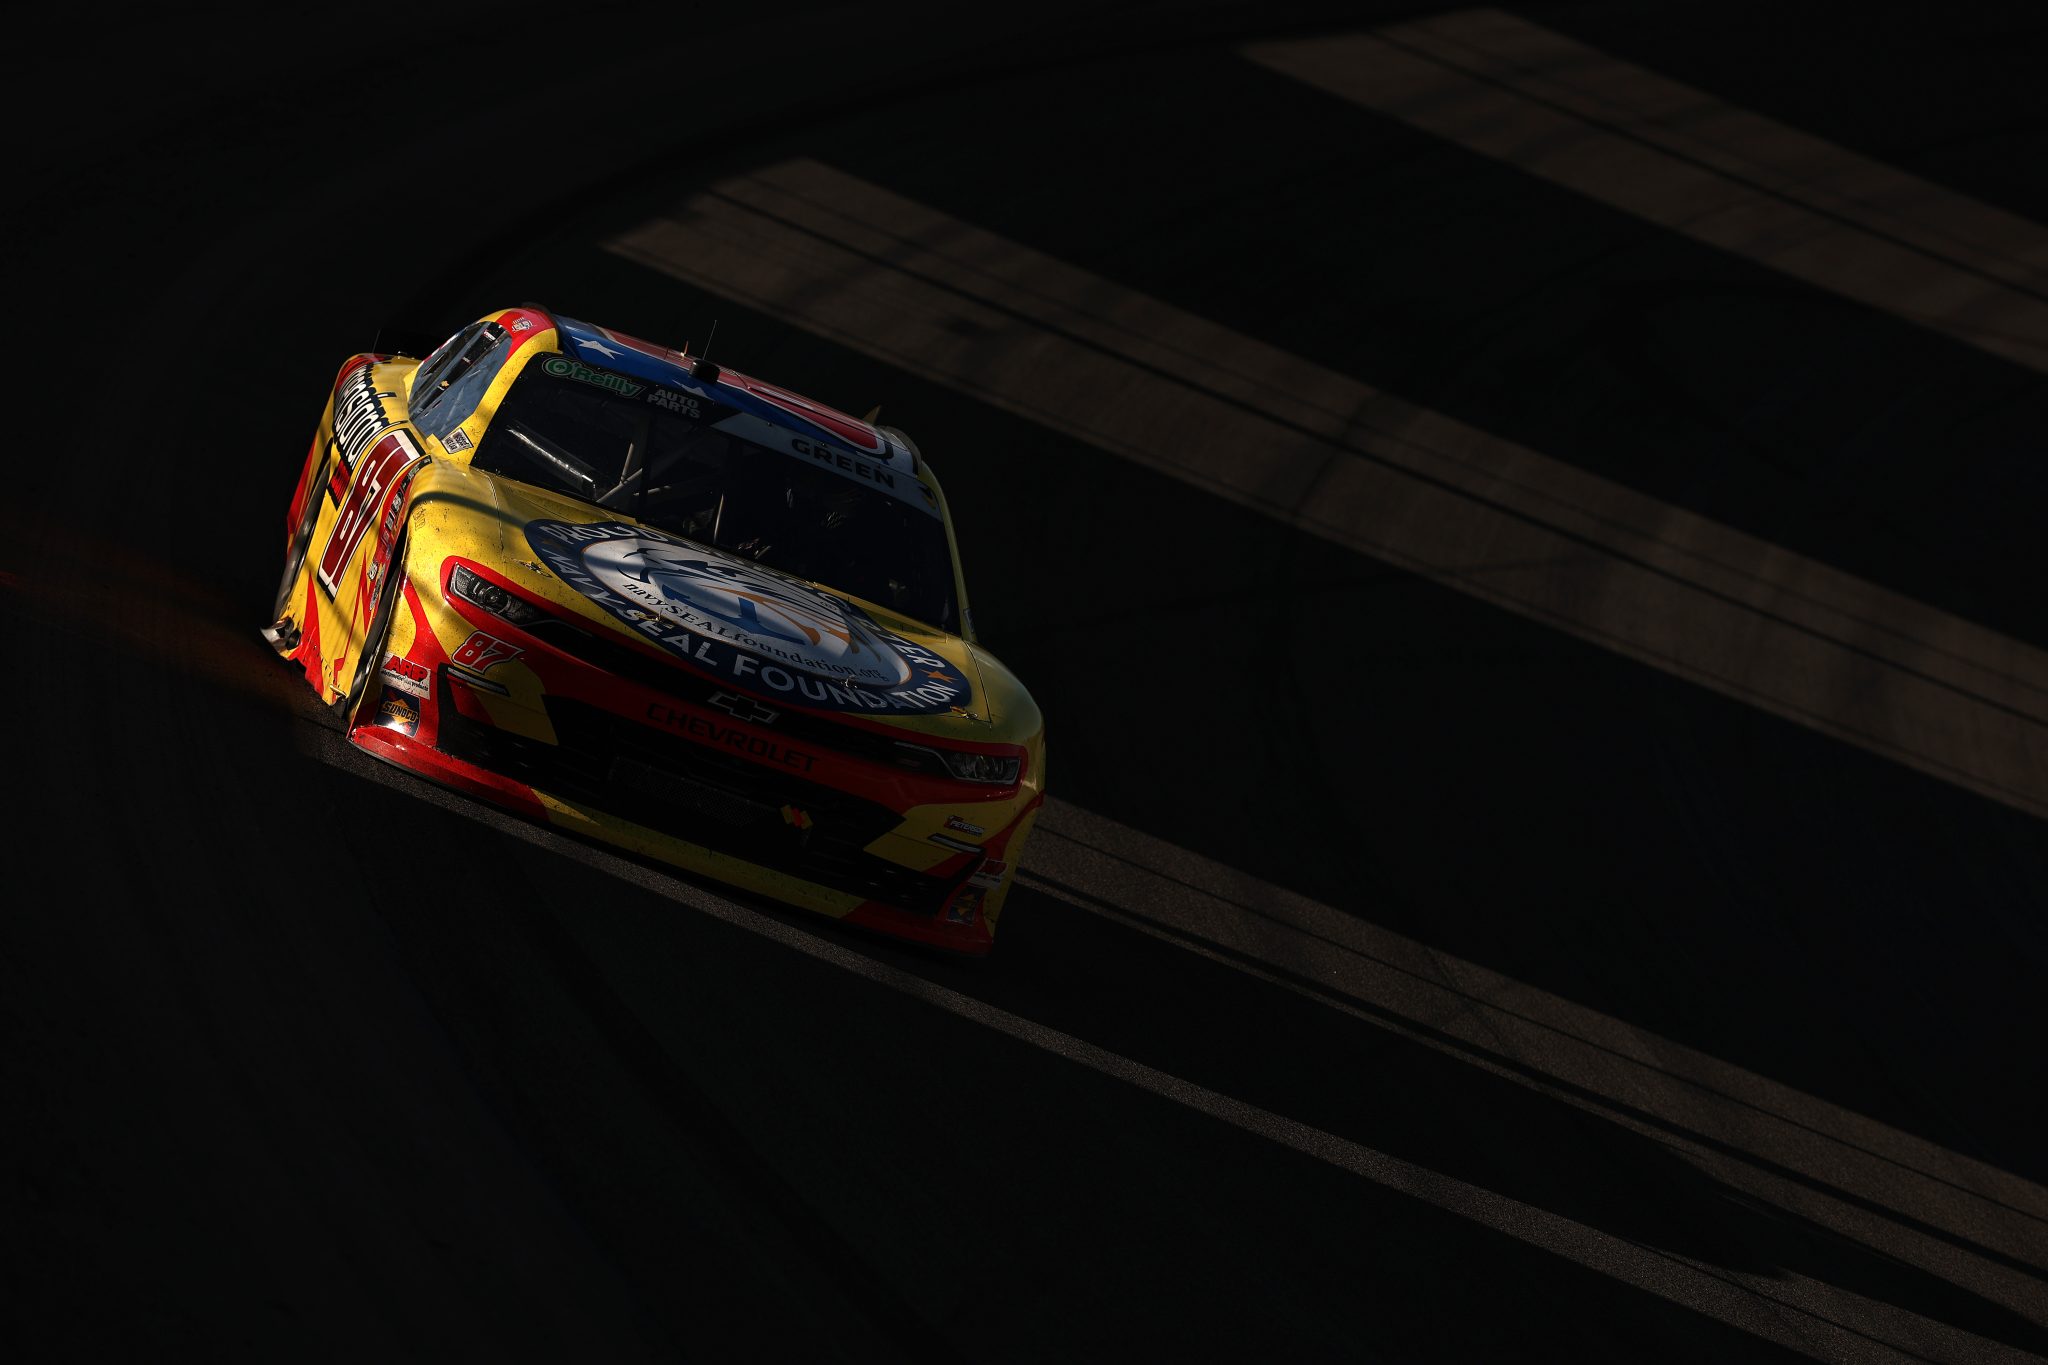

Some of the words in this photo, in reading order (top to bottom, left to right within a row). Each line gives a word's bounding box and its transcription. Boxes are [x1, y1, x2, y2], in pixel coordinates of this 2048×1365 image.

[542, 358, 647, 398] O'Reilly
[656, 389, 699, 409] AUTO
[646, 393, 701, 419] PARTS
[791, 438, 895, 489] GREEN
[317, 427, 427, 605] 87
[538, 523, 670, 546] PROUD
[541, 547, 627, 608] NAVY
[614, 608, 718, 667] SEAL
[732, 654, 960, 710] FOUNDATION
[623, 583, 890, 682] navySEALfoundation.org
[382, 654, 428, 682] ARP
[450, 628, 526, 676] 87
[382, 701, 419, 722] SUNOCO
[646, 702, 821, 772] CHEVROLET
